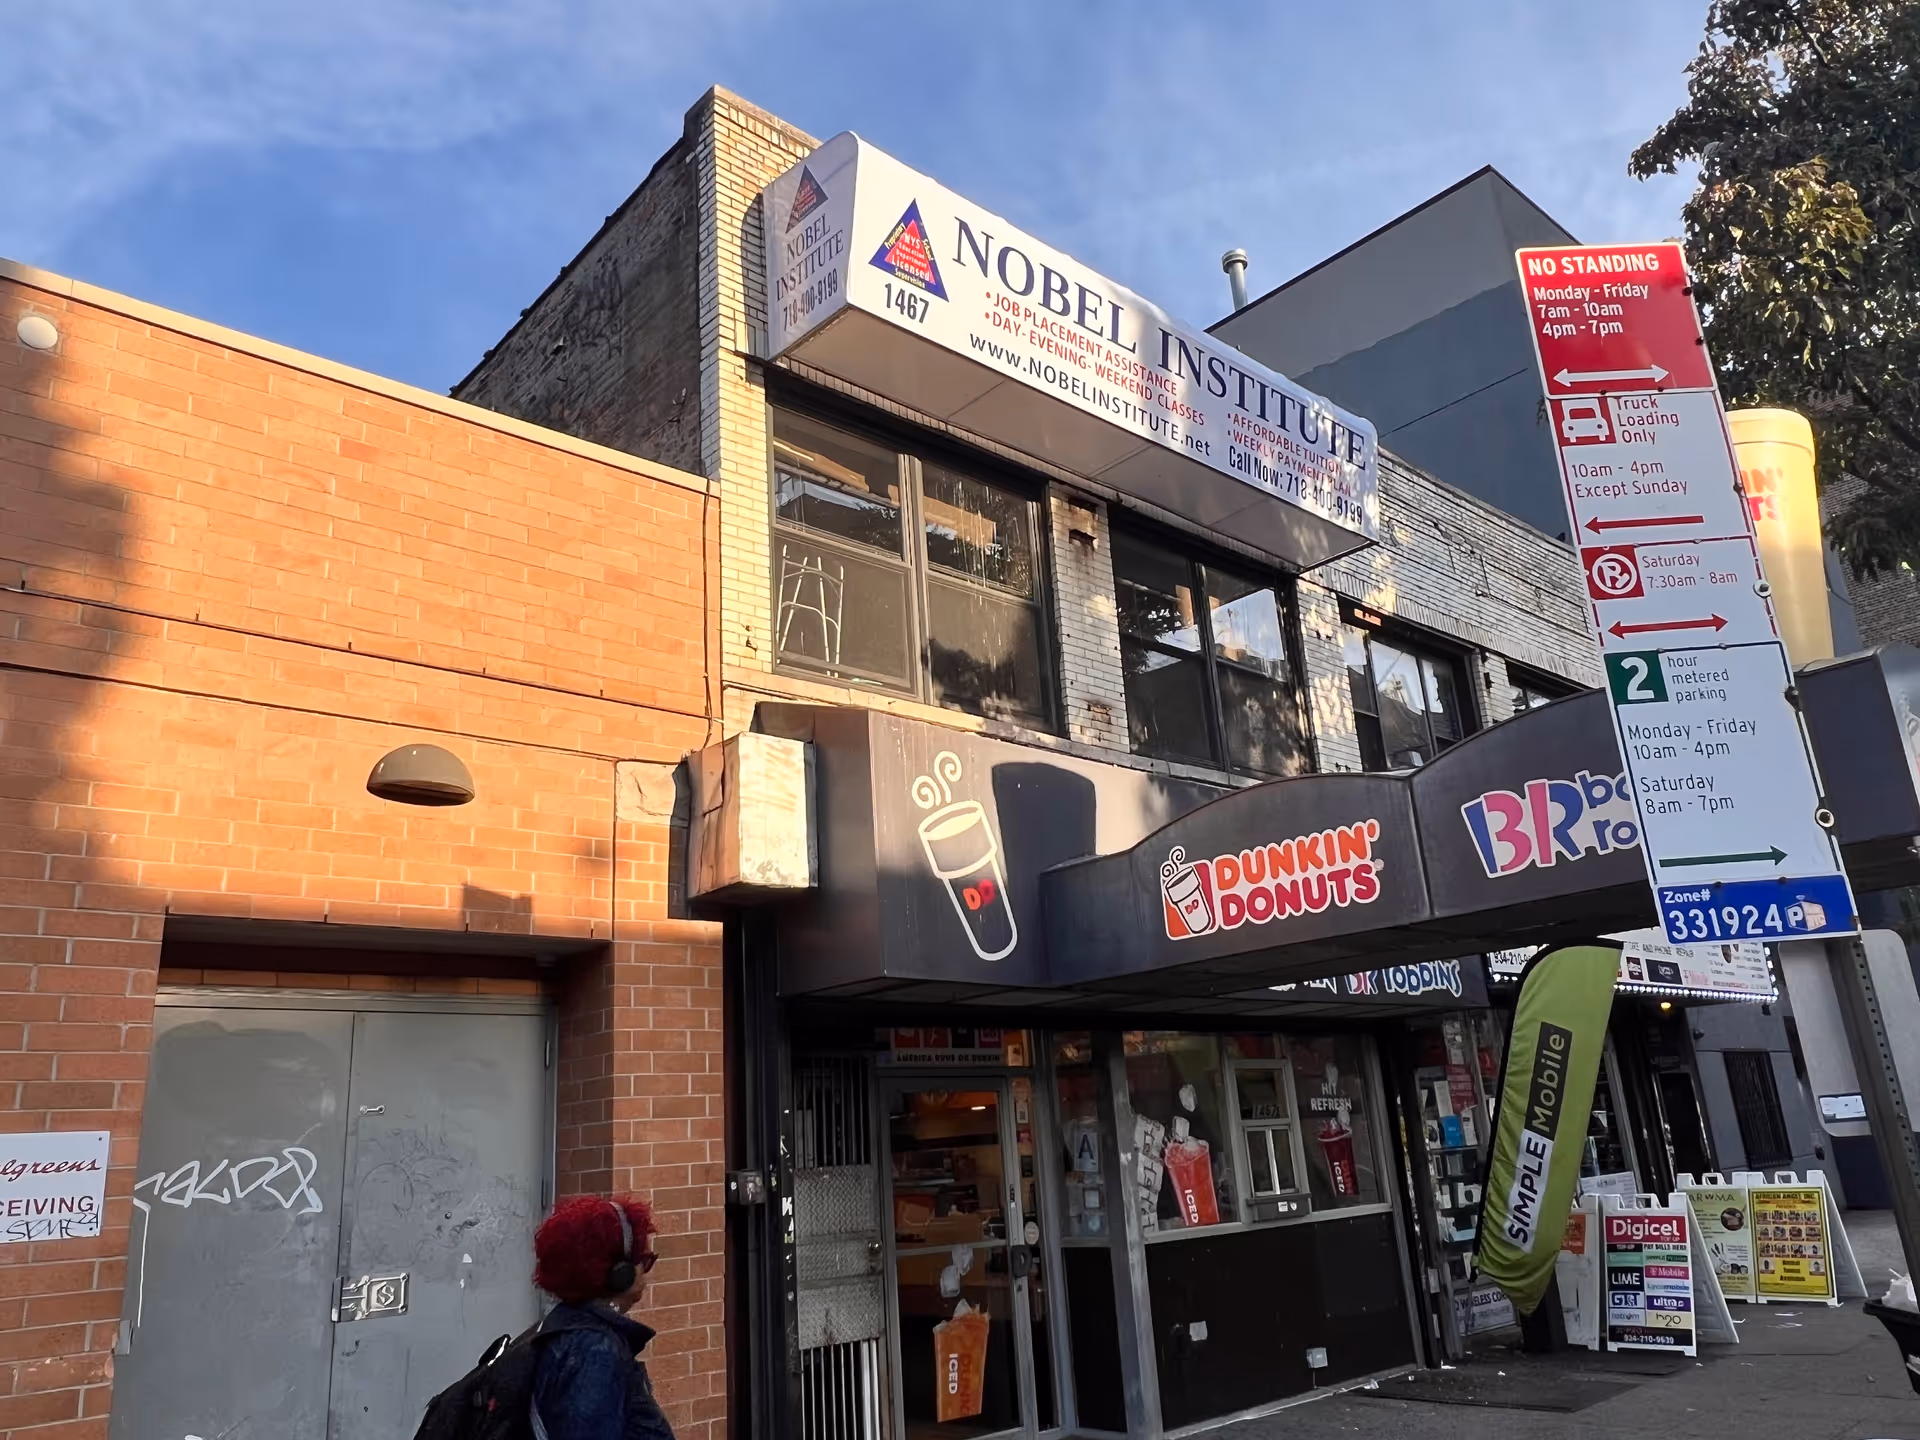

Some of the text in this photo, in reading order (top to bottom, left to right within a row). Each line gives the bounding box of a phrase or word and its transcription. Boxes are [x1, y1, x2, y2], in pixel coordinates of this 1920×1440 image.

[787, 213, 830, 265] NOBEL
[904, 233, 921, 249] NYS
[776, 229, 844, 302] INSTITUTE
[891, 255, 930, 281] Licensed
[1528, 253, 1659, 276] NO STANDING
[783, 268, 838, 332] 718-400-9199
[885, 283, 929, 324] 1467
[1534, 285, 1592, 301] Monday
[1604, 283, 1649, 301] Friday
[1538, 303, 1570, 319] 7am
[1583, 302, 1623, 317] 10am
[1542, 321, 1576, 339] 4pm
[1591, 320, 1623, 337] 7pm
[952, 216, 1366, 471] NOBEL INSTITUTE
[994, 293, 1177, 396] JOB PLACEMENT ASSISTANCE
[1095, 364, 1153, 401] WEEKEND
[1158, 393, 1205, 426] CLASSES
[1616, 395, 1658, 410] Truck
[1617, 411, 1679, 427] Loading
[1233, 413, 1343, 476] AFFORDABLE TUITION
[1622, 429, 1655, 445] Only
[1233, 430, 1275, 462] WEEKLY
[1278, 451, 1327, 483] PAYMENT
[1572, 464, 1612, 478] 10am
[1630, 461, 1664, 477] 4pm
[1229, 446, 1362, 526] Call Now: 718-400-9199
[1575, 479, 1687, 499] Except Sunday
[1642, 554, 1700, 569] Saturday
[1647, 575, 1696, 589] 7:30am
[1709, 572, 1738, 585] 8am
[1667, 655, 1699, 668] hour
[1621, 656, 1655, 700] 2
[1672, 669, 1729, 684] metered
[1675, 686, 1727, 703] parking
[1627, 722, 1691, 741] Monday
[1707, 718, 1757, 737] Friday
[1633, 744, 1677, 760] 10am
[1694, 741, 1730, 758] 4pm
[1641, 774, 1715, 793] Saturday
[1645, 799, 1682, 814] 8am
[1698, 796, 1735, 814] 7pm
[1463, 781, 1584, 874] BR
[1215, 822, 1376, 891] DUNKIN'
[1221, 863, 1376, 927] DONUTS
[1663, 888, 1711, 904] Zone#
[1669, 903, 1783, 940] 331924
[1321, 1082, 1338, 1096] HIT
[1532, 1034, 1565, 1134] Mobile
[1310, 1097, 1352, 1111] REFRESH
[1079, 1134, 1094, 1159] A
[0, 1158, 102, 1182] lgreens
[1334, 1162, 1345, 1193] ICED
[1509, 1137, 1546, 1244] SIMPLE
[1185, 1189, 1199, 1224] ICED
[1613, 1219, 1680, 1240] Digicel
[1612, 1273, 1640, 1285] LIME
[949, 1353, 958, 1394] ICED
